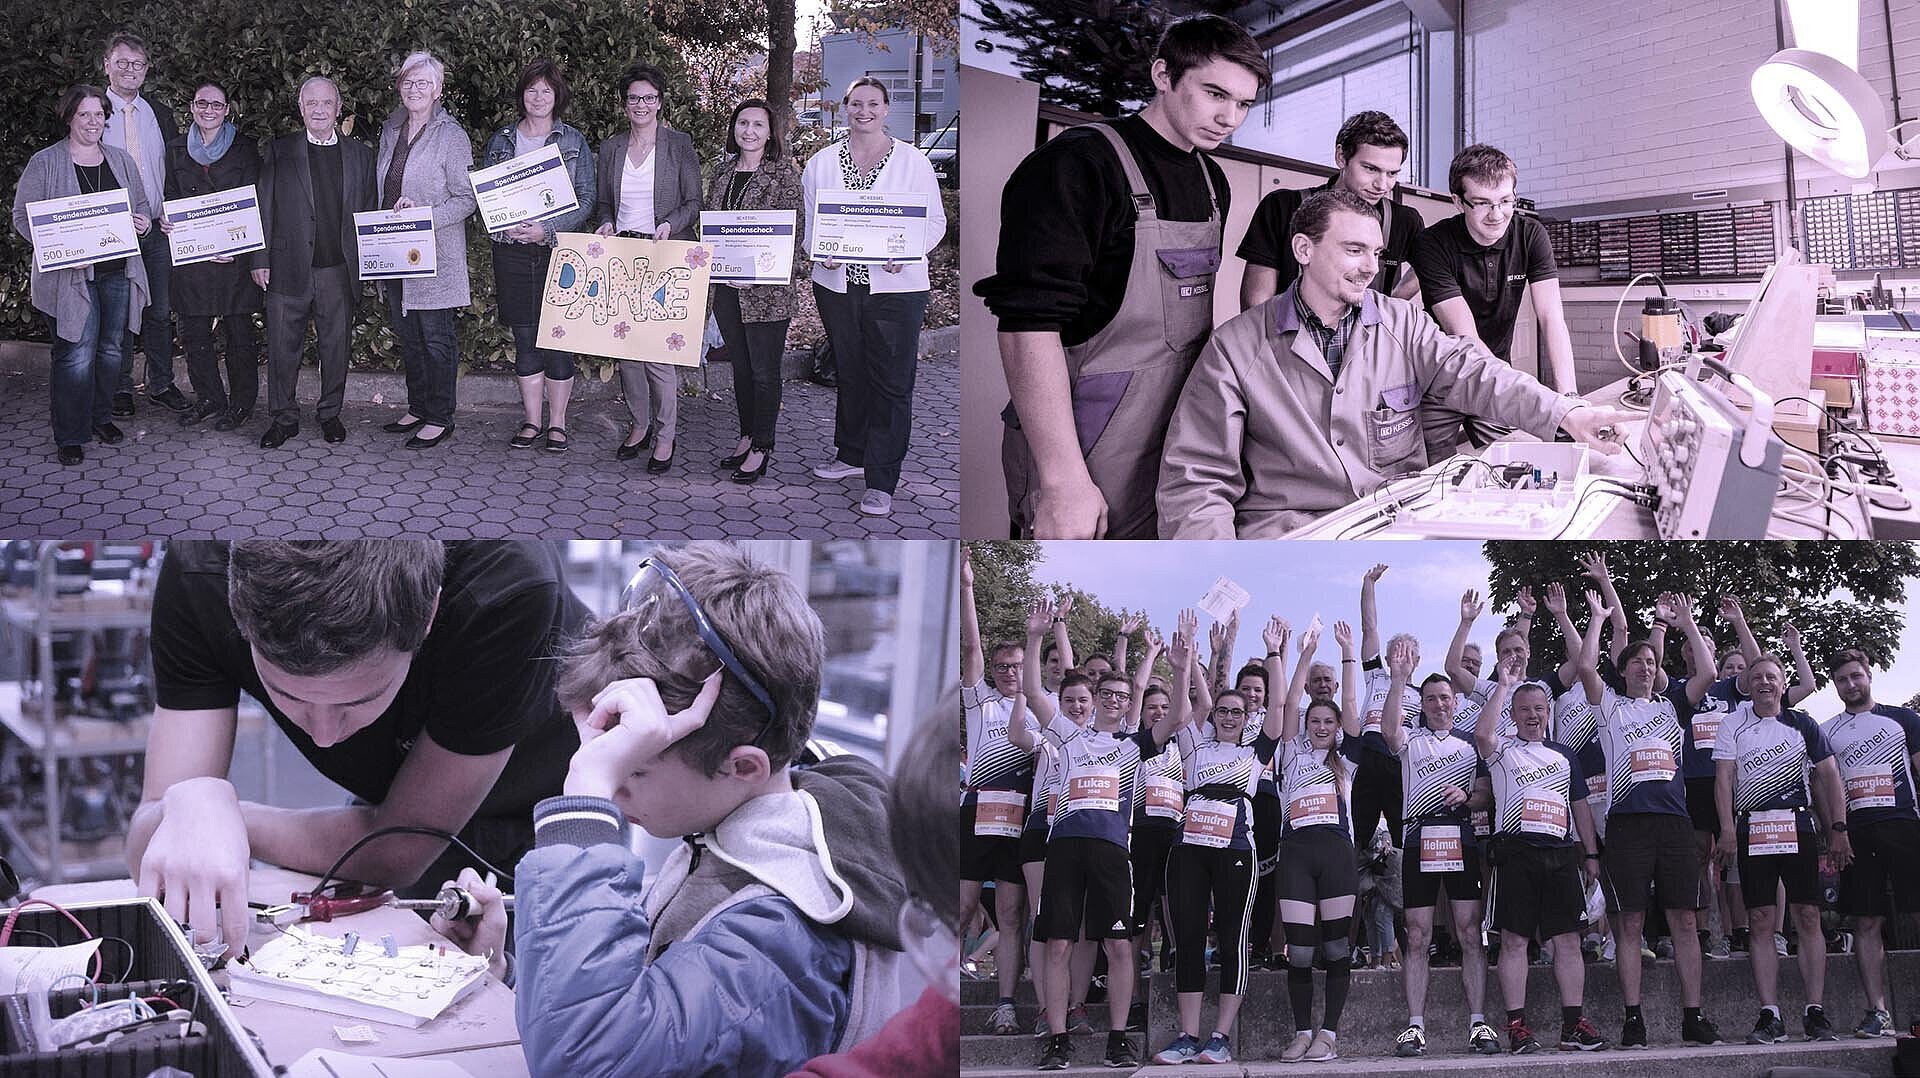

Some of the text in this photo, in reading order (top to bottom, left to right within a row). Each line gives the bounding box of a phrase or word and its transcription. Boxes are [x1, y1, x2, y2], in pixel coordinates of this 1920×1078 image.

[494, 164, 545, 187] Spendenscheck
[52, 206, 110, 222] Spendenscheck
[186, 203, 239, 219] Spendenscheck
[489, 213, 507, 223] 500
[509, 209, 528, 219] Euro
[840, 205, 904, 215] Spendenscheck
[372, 222, 417, 233] Spendenscheck
[720, 226, 774, 234] Spendenscheck
[43, 247, 85, 261] 500 Euro
[177, 243, 215, 255] 500 Euro
[818, 241, 864, 253] 500 Euro
[363, 260, 394, 270] 500 Euro
[710, 262, 742, 273] 00 Euro
[545, 248, 692, 326] DANKE
[1393, 416, 1415, 433] KESSEL
[1624, 711, 1671, 744] macher!
[1695, 723, 1719, 732] Thom
[1845, 728, 1890, 768] macher!
[1636, 750, 1669, 761] Martin
[1743, 739, 1792, 774] macher!
[1197, 756, 1243, 782] macher!
[1417, 750, 1464, 779] macher!
[1515, 760, 1564, 787] macher!
[1077, 778, 1111, 789] Lukas
[1847, 776, 1892, 791] Georgios
[1152, 787, 1182, 802] Janine
[1299, 797, 1326, 808] Anna
[1526, 800, 1565, 816] Gerhard
[1191, 811, 1229, 827] Sandra
[1749, 822, 1795, 835] Reinhard
[1423, 839, 1458, 850] Helmut
